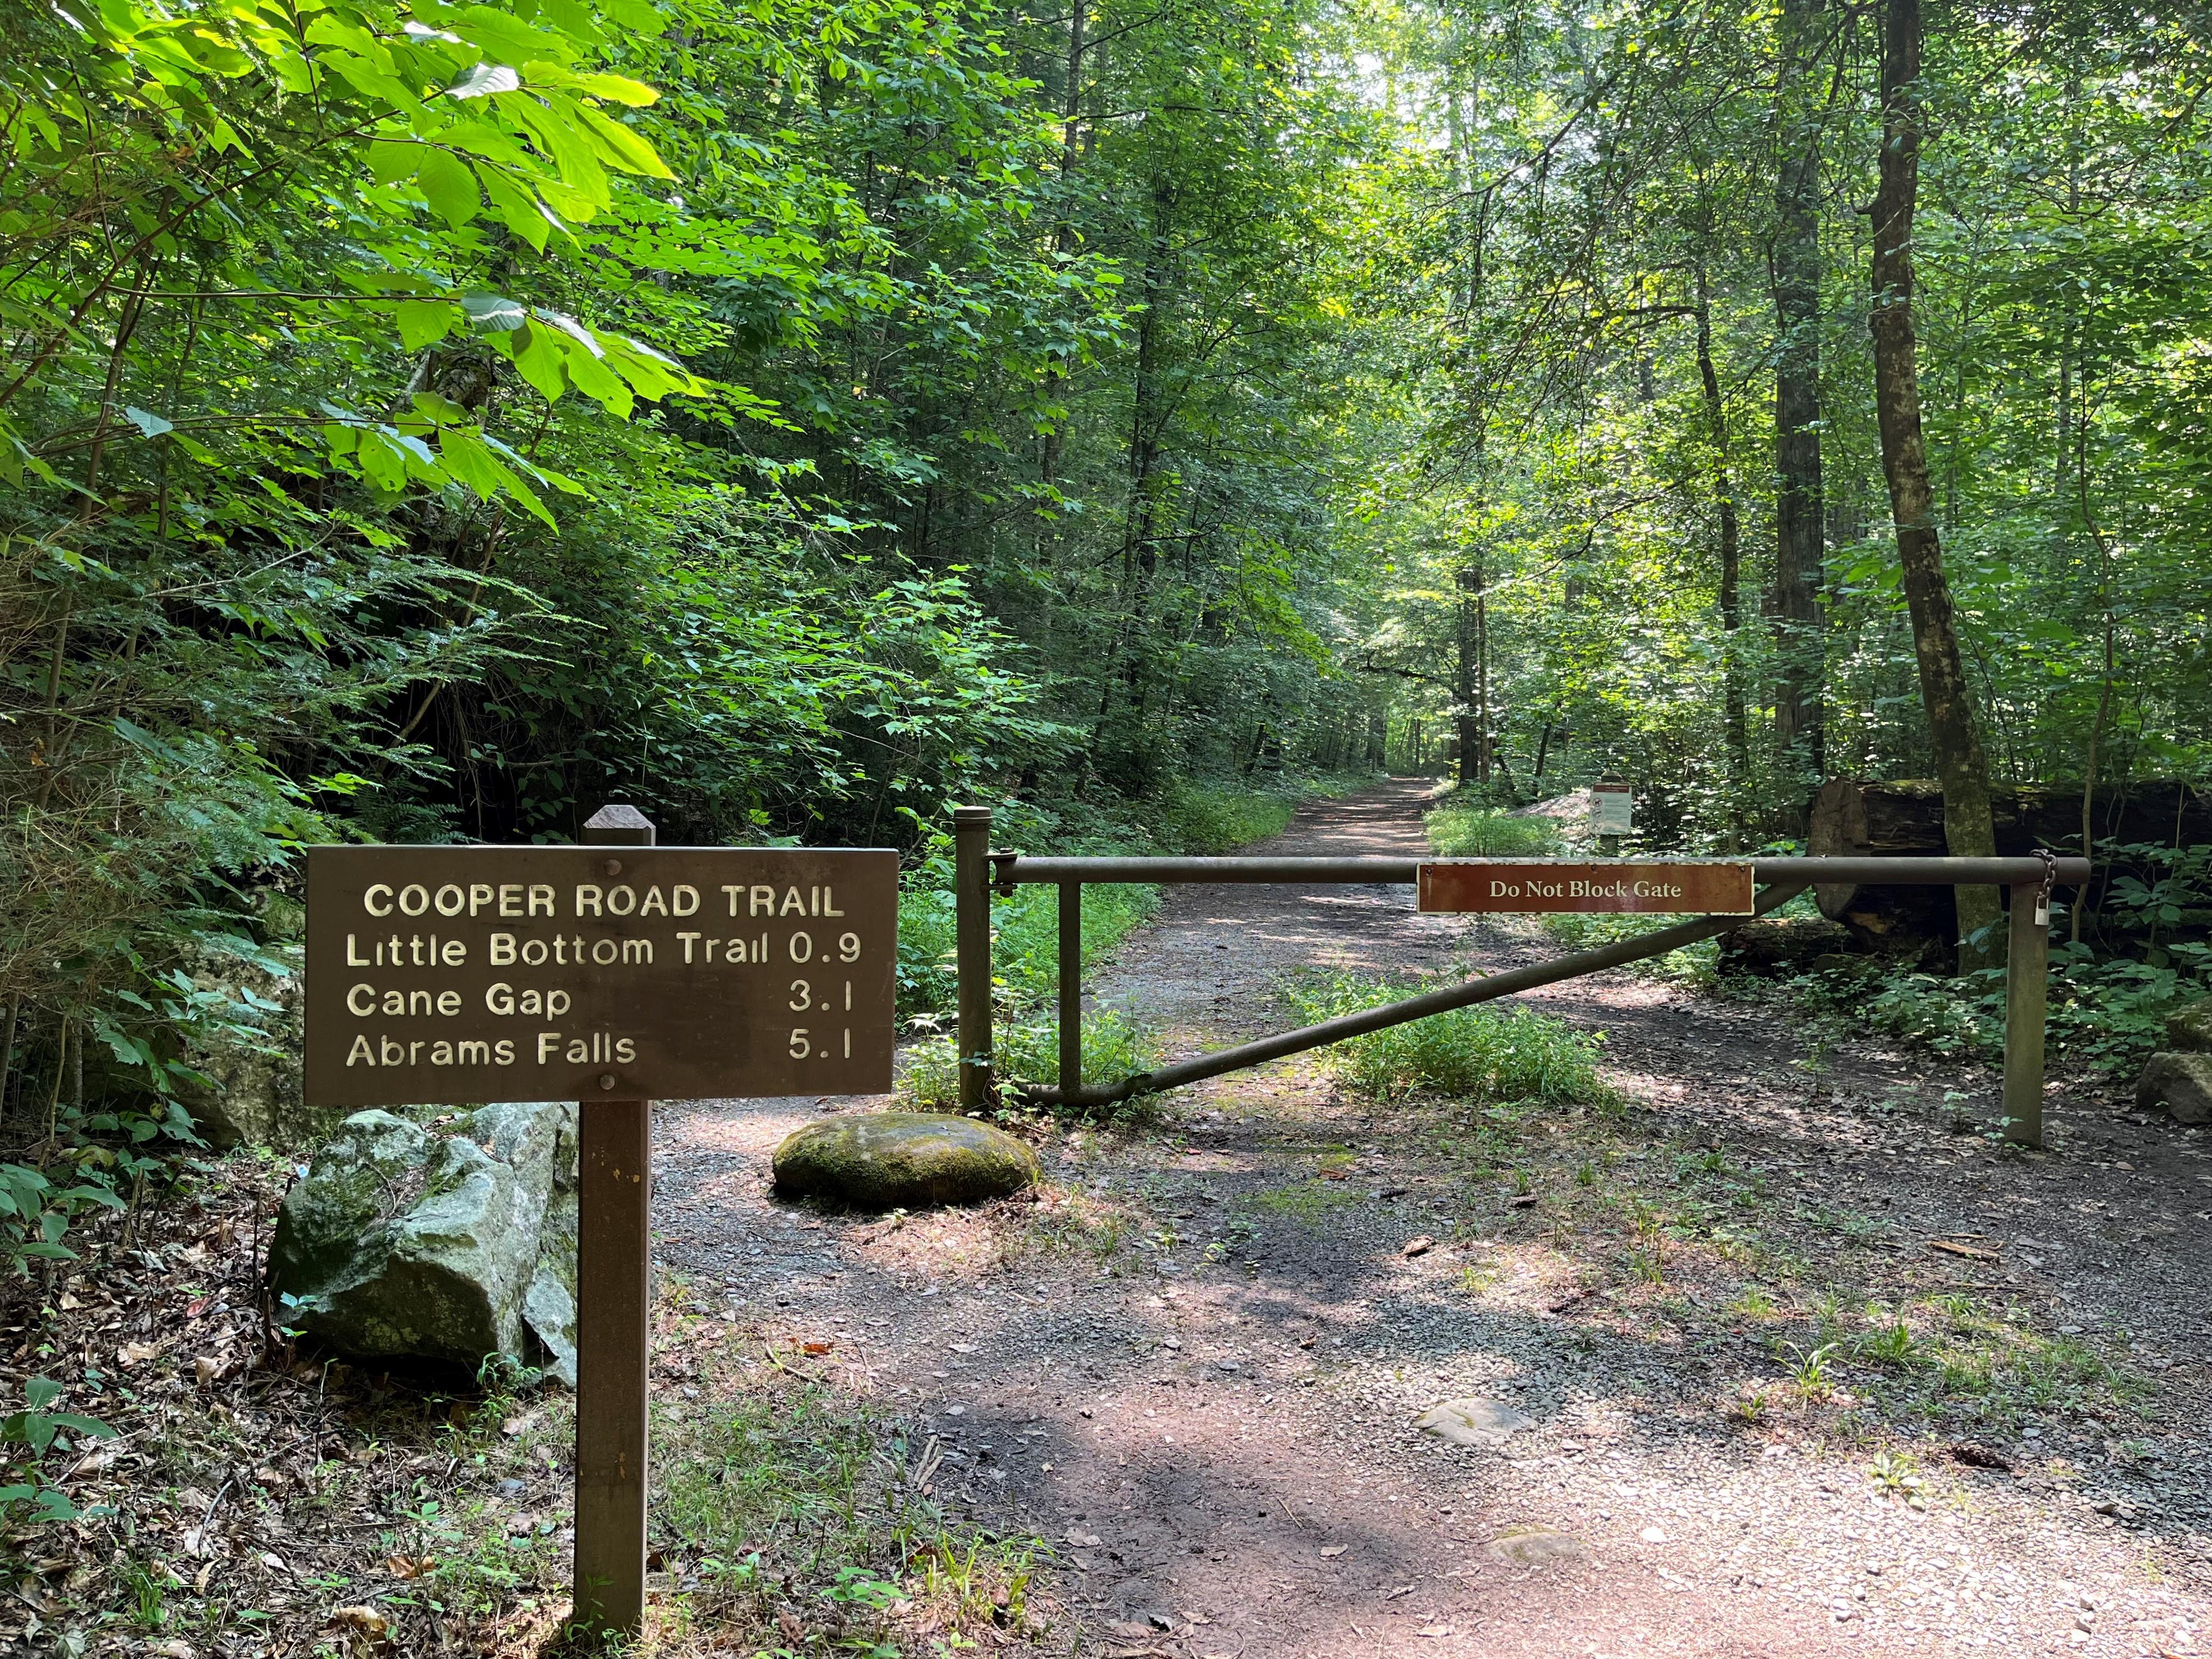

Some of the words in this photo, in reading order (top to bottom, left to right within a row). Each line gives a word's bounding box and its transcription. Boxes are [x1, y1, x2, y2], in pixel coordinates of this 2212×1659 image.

[364, 884, 556, 917] COOPER
[576, 884, 700, 917] ROAD
[721, 885, 844, 917] TRAIL
[1490, 881, 1519, 897] Do
[1526, 881, 1564, 897] Not
[1569, 879, 1628, 897] Block
[1633, 881, 1681, 897] Gate
[347, 934, 467, 966] Little
[490, 933, 653, 966] Bottom
[676, 932, 768, 964] Trail
[789, 931, 860, 963] 0.9
[347, 982, 462, 1017] Cane
[485, 982, 571, 1021] Gap
[789, 979, 851, 1012] 3.1
[346, 1035, 515, 1067] Abrams
[538, 1032, 636, 1064] Falls
[789, 1029, 850, 1059] 5.1
